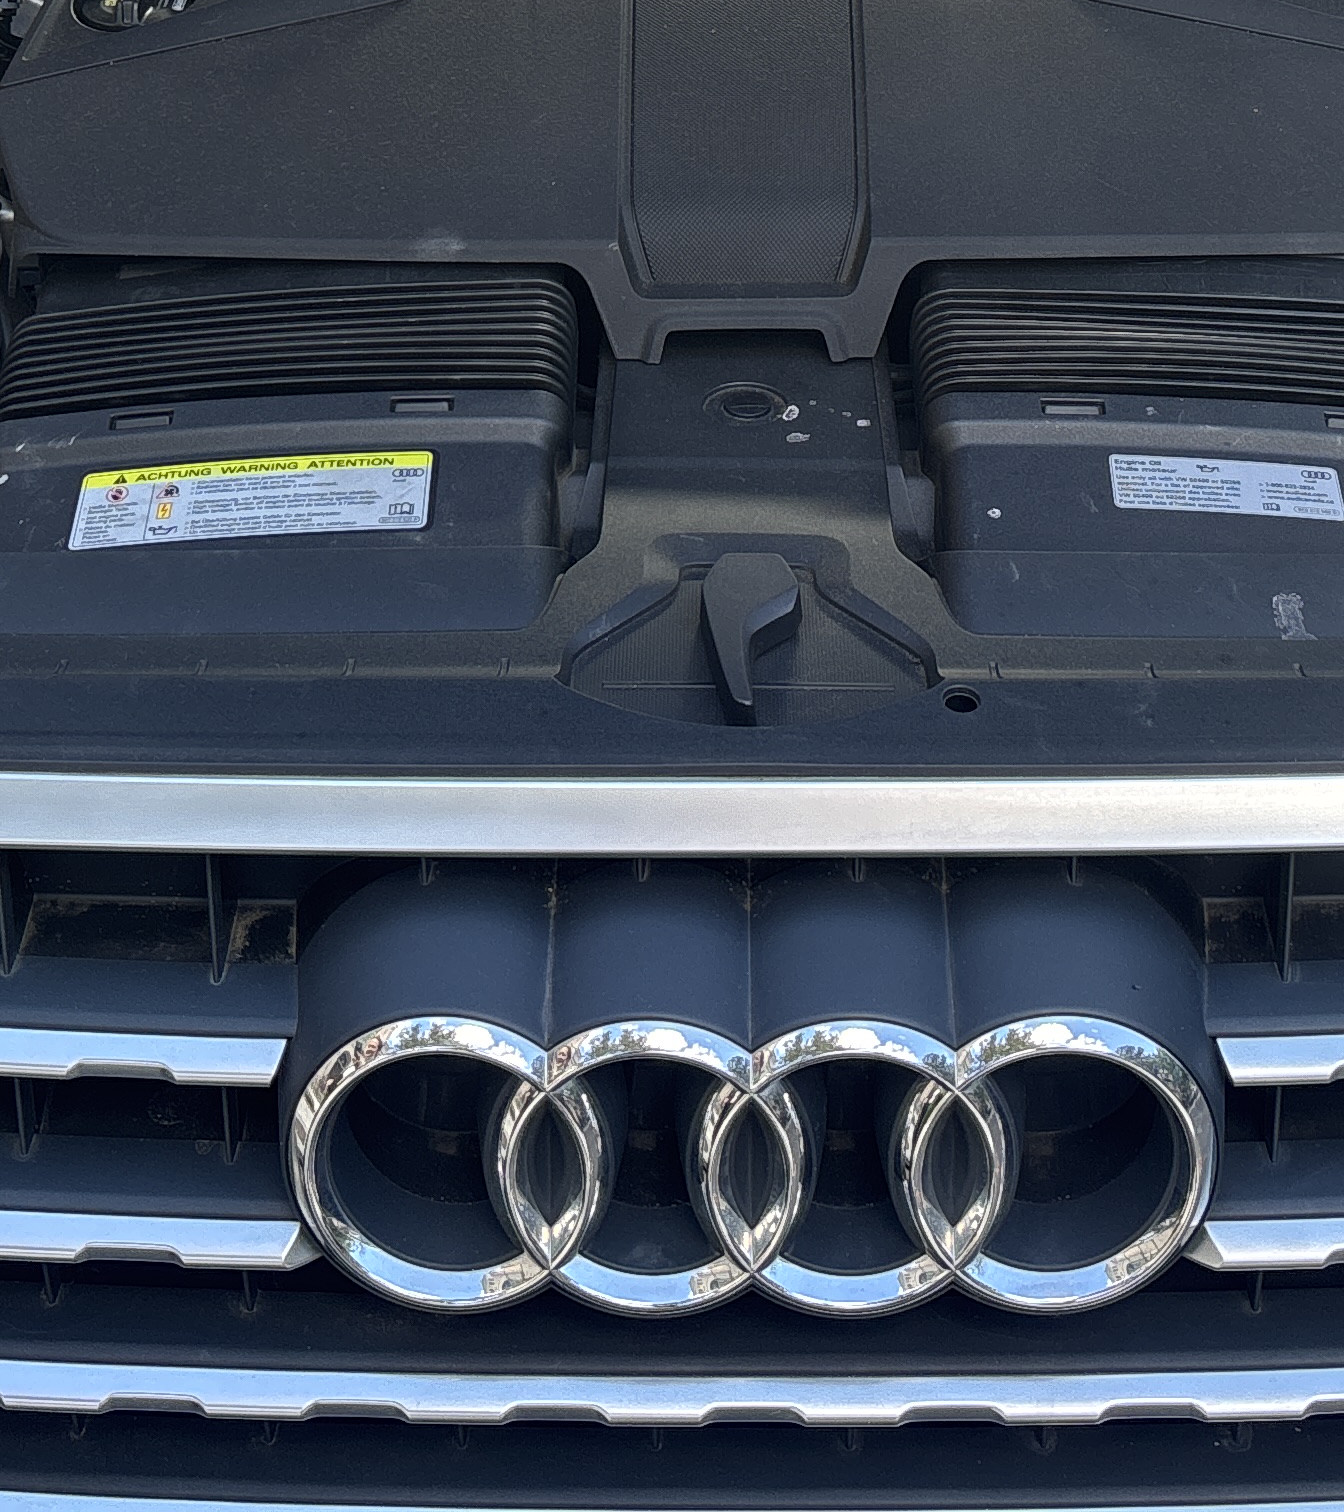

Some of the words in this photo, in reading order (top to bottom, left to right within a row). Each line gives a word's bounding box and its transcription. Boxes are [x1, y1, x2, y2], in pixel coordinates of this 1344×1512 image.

[134, 467, 212, 483] ACHTUNG
[220, 460, 299, 475] WARNING
[306, 457, 395, 470] ATTENTION
[1114, 458, 1146, 466] Engine
